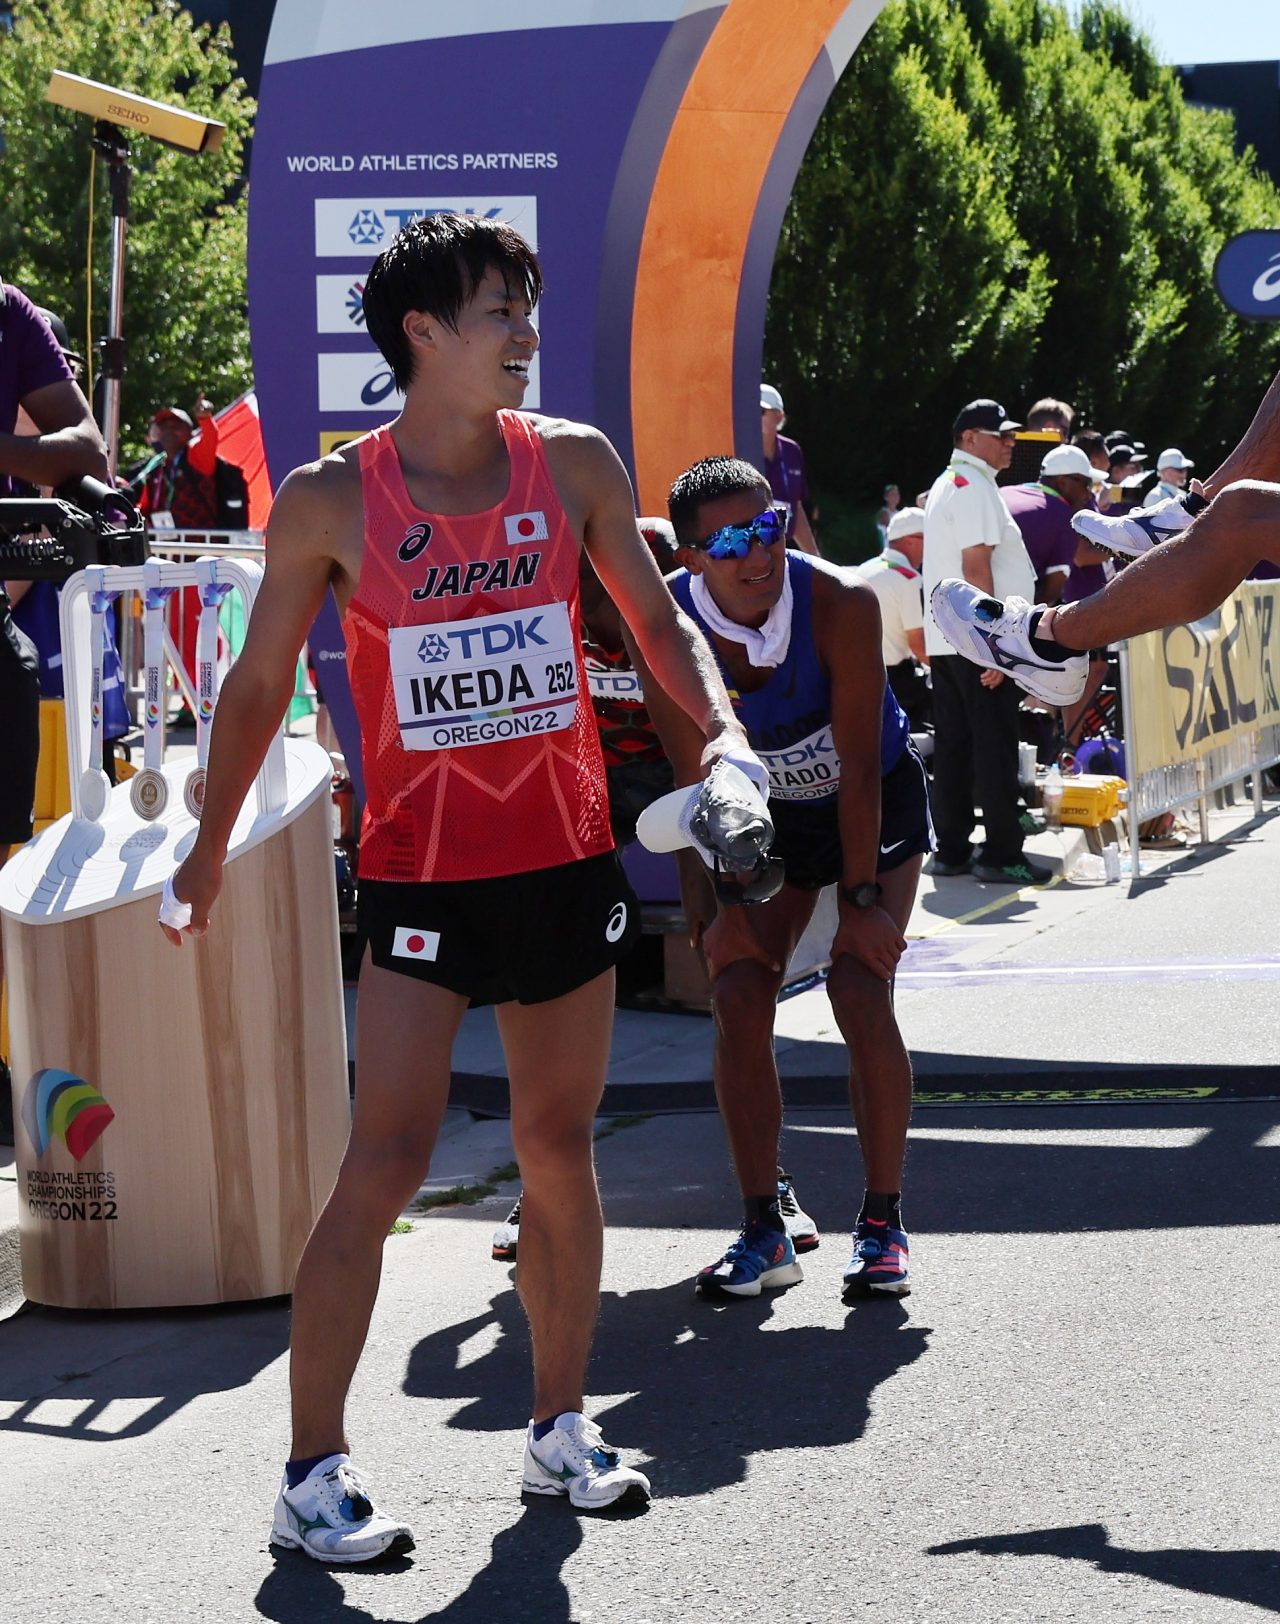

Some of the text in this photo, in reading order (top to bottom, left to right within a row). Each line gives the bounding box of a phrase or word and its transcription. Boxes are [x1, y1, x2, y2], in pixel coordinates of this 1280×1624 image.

[107, 104, 150, 124] SEIKO
[287, 153, 558, 172] WORLD ATHLETICS PARTNERS
[412, 552, 541, 601] JAPAN
[447, 615, 549, 660] TDK
[410, 661, 575, 716] IKEDA 252
[433, 711, 559, 746] OREGON22
[757, 734, 835, 767] TDK
[769, 783, 839, 799] REGON2
[27, 1170, 115, 1184] WORLD ATHLETICS
[28, 1184, 116, 1199] CHAMPIONSHIPS
